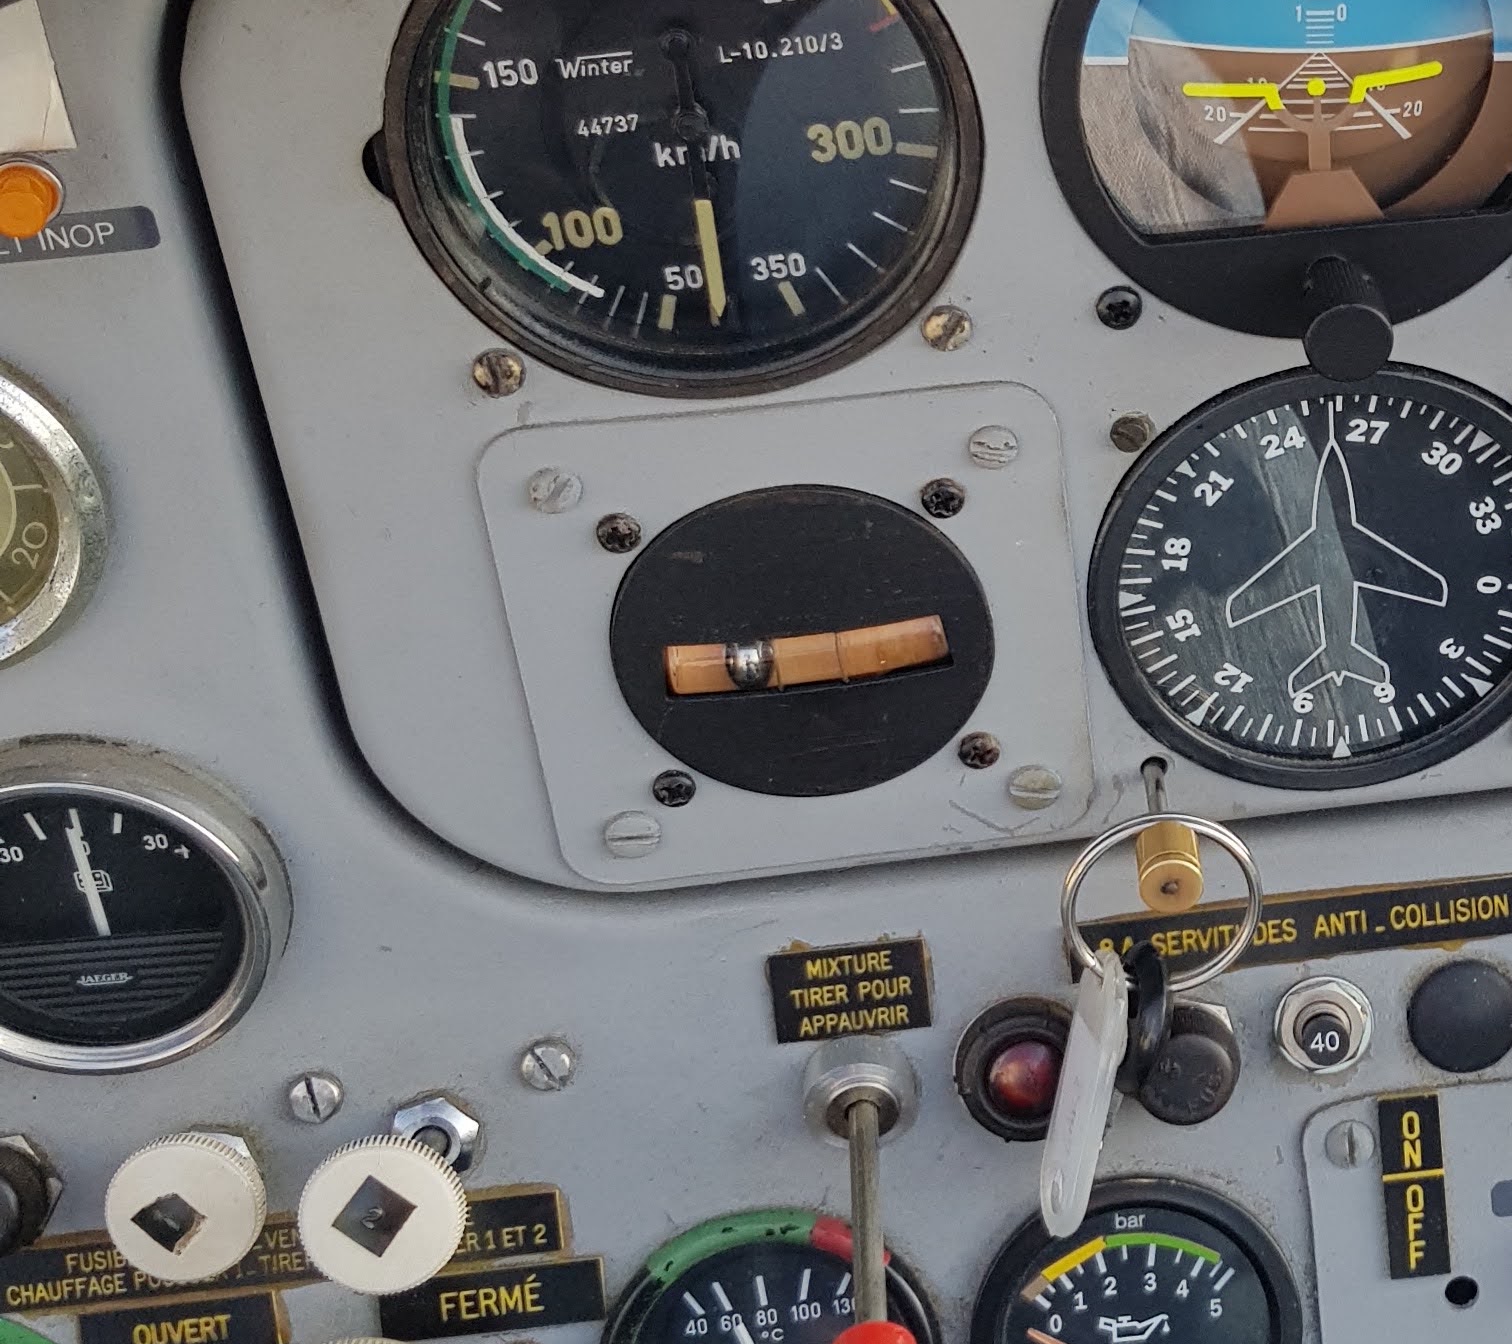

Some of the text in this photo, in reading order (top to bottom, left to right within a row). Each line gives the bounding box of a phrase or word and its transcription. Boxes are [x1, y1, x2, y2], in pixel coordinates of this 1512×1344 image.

[719, 32, 843, 64] L-10.210/3
[483, 51, 634, 88] 150 Winter
[577, 114, 639, 137] 44737
[1204, 100, 1423, 123] 20 20
[806, 117, 892, 163] 300
[38, 222, 114, 251] INOP
[541, 207, 623, 250] 100
[663, 265, 703, 291] 50
[751, 253, 807, 281] 350
[1260, 425, 1306, 460] 24
[1345, 418, 1390, 444] 27
[1421, 441, 1463, 475] 30
[1194, 474, 1235, 507] 21
[1469, 496, 1502, 535] 33
[1161, 537, 1192, 572] 18
[1476, 576, 1502, 593] 0
[1165, 608, 1202, 643] 15
[1439, 637, 1465, 659] 3
[1214, 662, 1254, 694] 12
[143, 833, 168, 851] 30
[1152, 917, 1297, 956] SERVITDES
[78, 972, 129, 984] JAEGER
[805, 950, 893, 980] MIXTURE
[790, 976, 912, 1009] TIRER POUR
[800, 1005, 910, 1037] APPAUVRIR
[1310, 1030, 1341, 1053] 40
[1402, 1110, 1423, 1170] ON
[502, 1226, 526, 1248] ET
[533, 1224, 548, 1244] 2
[1115, 1213, 1146, 1229] bar
[1406, 1184, 1426, 1270] OFF
[5, 1273, 127, 1306] CHAUFFAGE
[439, 1274, 546, 1323] FERMÉ
[1050, 1273, 1223, 1333] 0 1 2 3 4 5
[685, 1302, 821, 1335] 40 60 80 100
